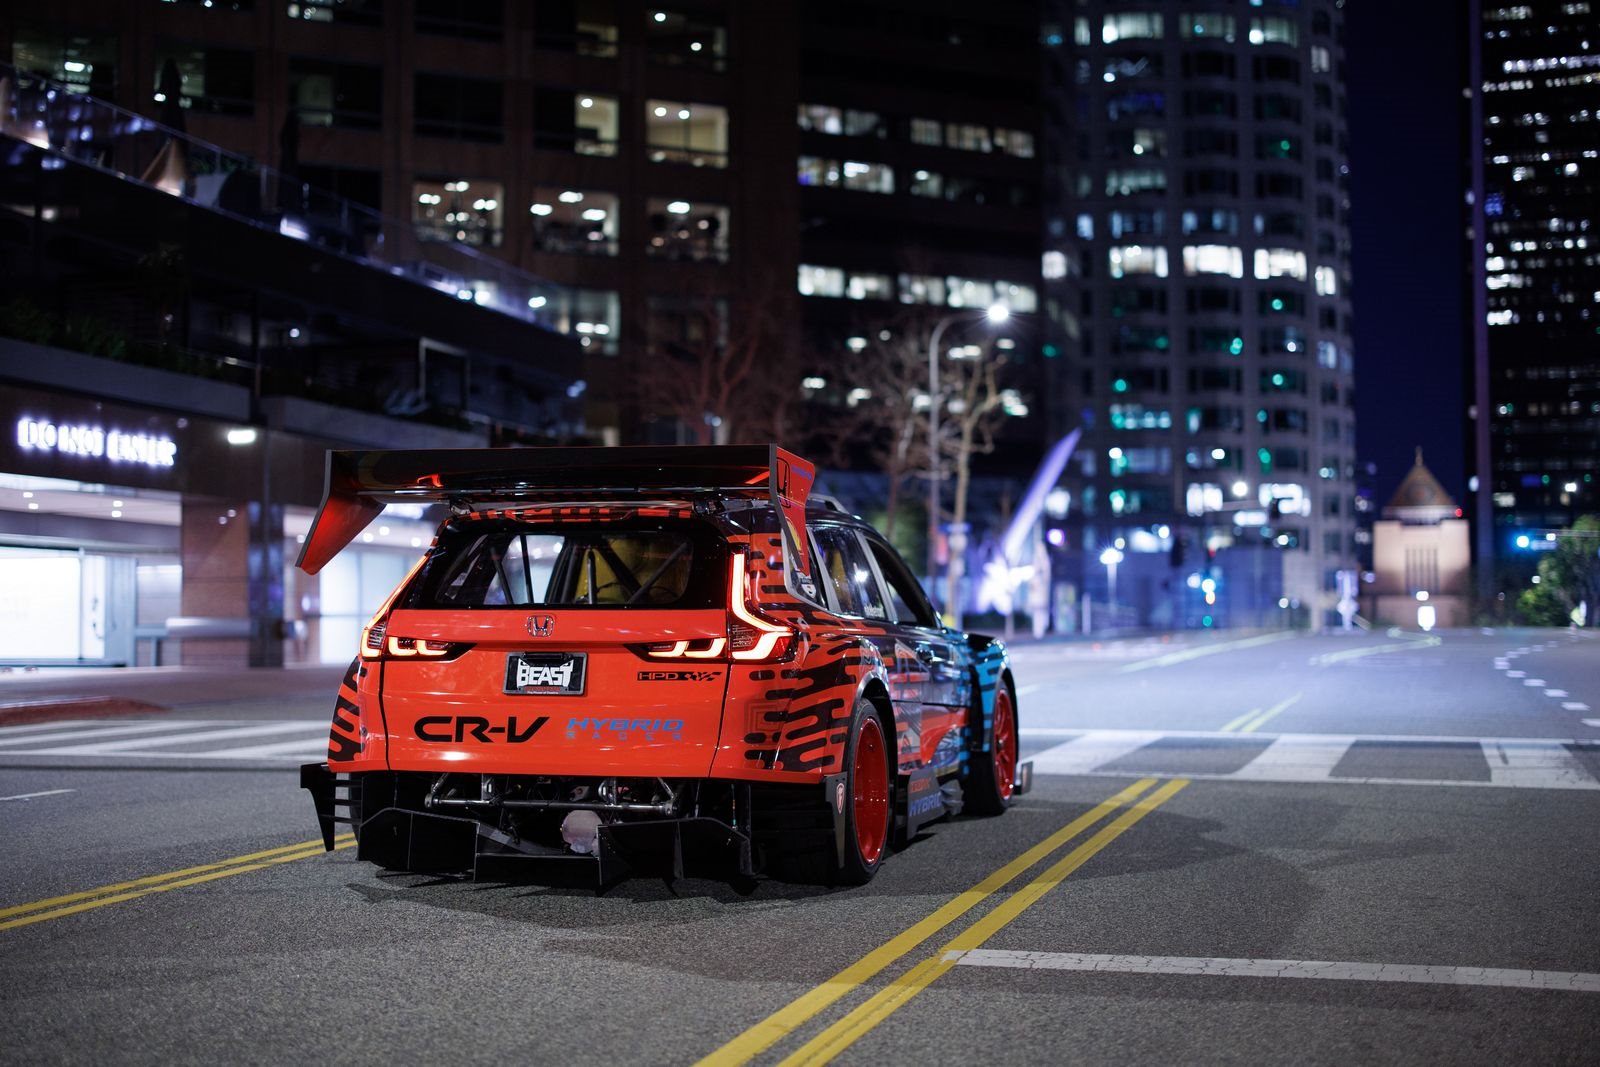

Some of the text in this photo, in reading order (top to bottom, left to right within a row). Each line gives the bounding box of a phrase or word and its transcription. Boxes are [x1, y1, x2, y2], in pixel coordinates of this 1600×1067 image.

[517, 658, 574, 688] BEAST
[638, 672, 679, 680] HPD
[414, 716, 550, 743] CR-V
[567, 718, 684, 731] HYBRID
